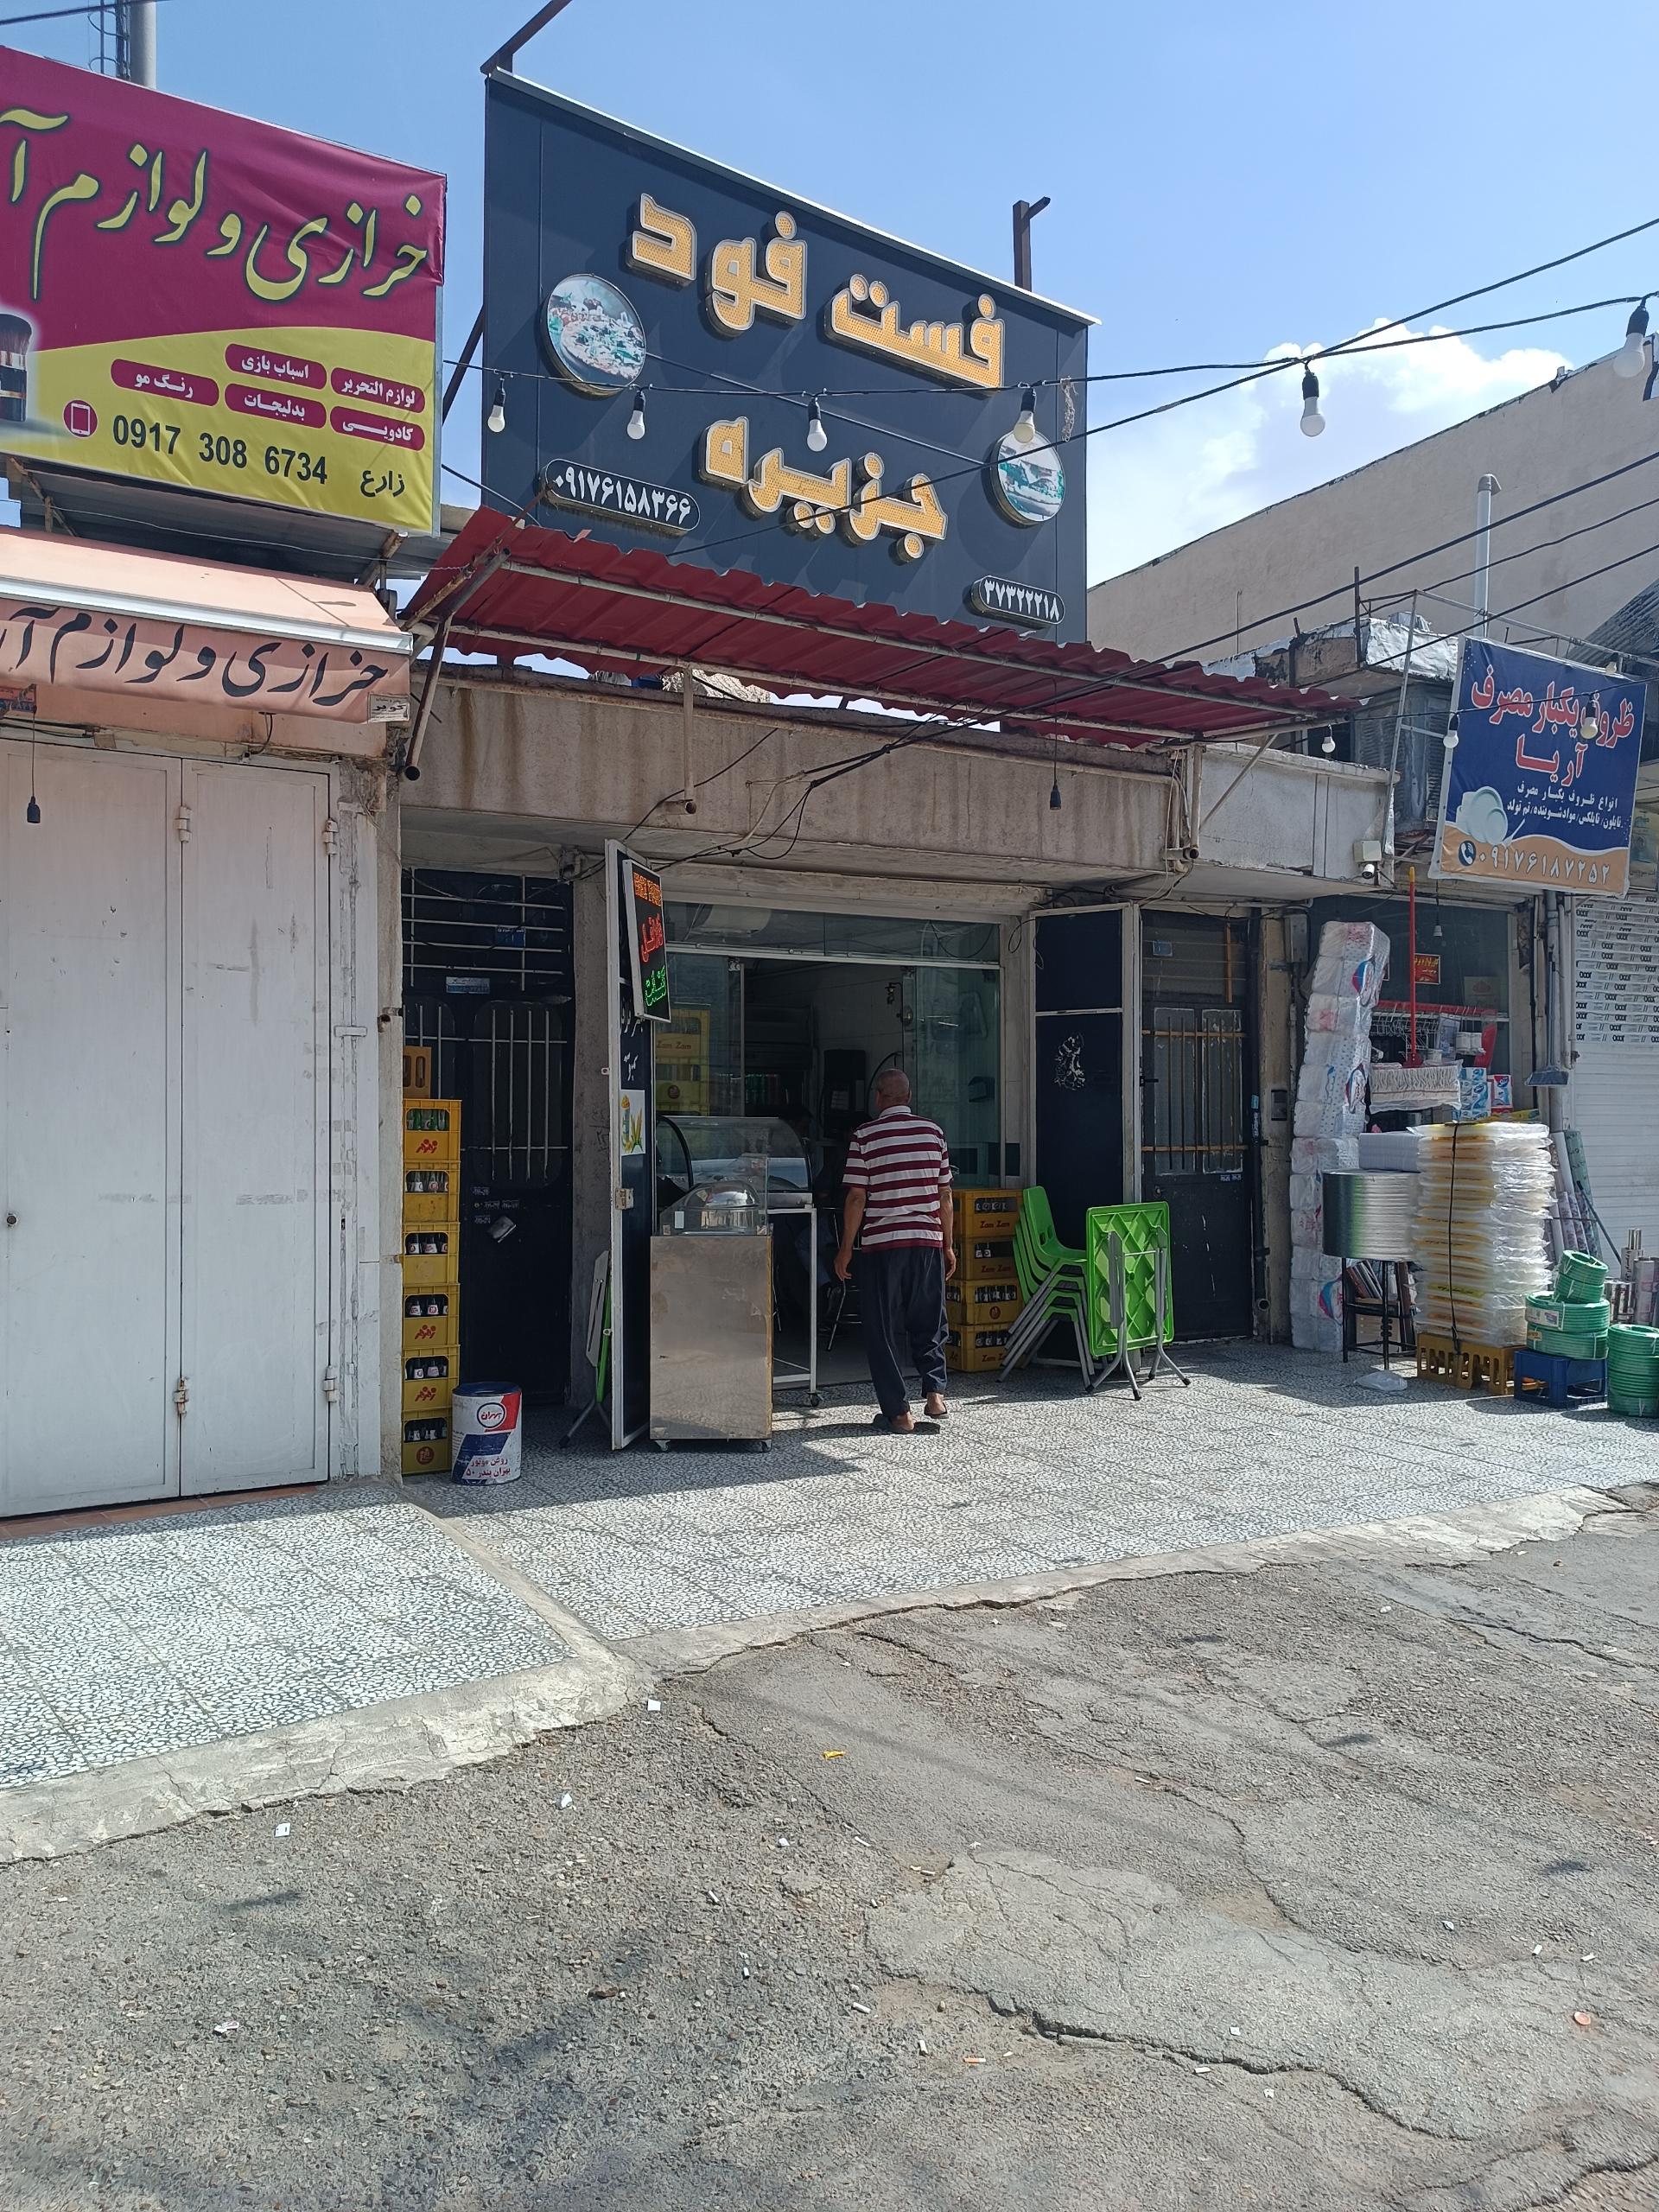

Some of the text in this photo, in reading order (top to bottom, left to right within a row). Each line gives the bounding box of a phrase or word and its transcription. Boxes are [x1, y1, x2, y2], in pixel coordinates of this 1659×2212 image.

[31, 143, 207, 301] لوازم
[207, 213, 242, 256] و
[245, 194, 428, 301] خرازی
[629, 192, 1006, 391] فست فود
[134, 372, 194, 399] رنگ مو
[241, 354, 309, 379] اسباب بازی
[244, 394, 306, 422] بدلیجات
[340, 378, 417, 407] لوازم التحریر
[112, 415, 327, 485] 0917 308 6734
[359, 469, 405, 498] زارع
[553, 466, 691, 525] ۰۹۱۷۶۱۵۸۳۶۶
[702, 415, 948, 560] جزیره
[984, 578, 1060, 622] ۳۷۳۲۲۲۱۸
[49, 612, 185, 684] لوازم
[175, 645, 217, 682] و
[221, 641, 389, 707] خرازی
[1471, 664, 1534, 725] مصرف
[1531, 680, 1580, 739] یکبار
[1515, 733, 1589, 787] آریا
[1516, 780, 1539, 798] مصرف
[1568, 789, 1595, 807] ظروف
[1598, 795, 1618, 812] انواع
